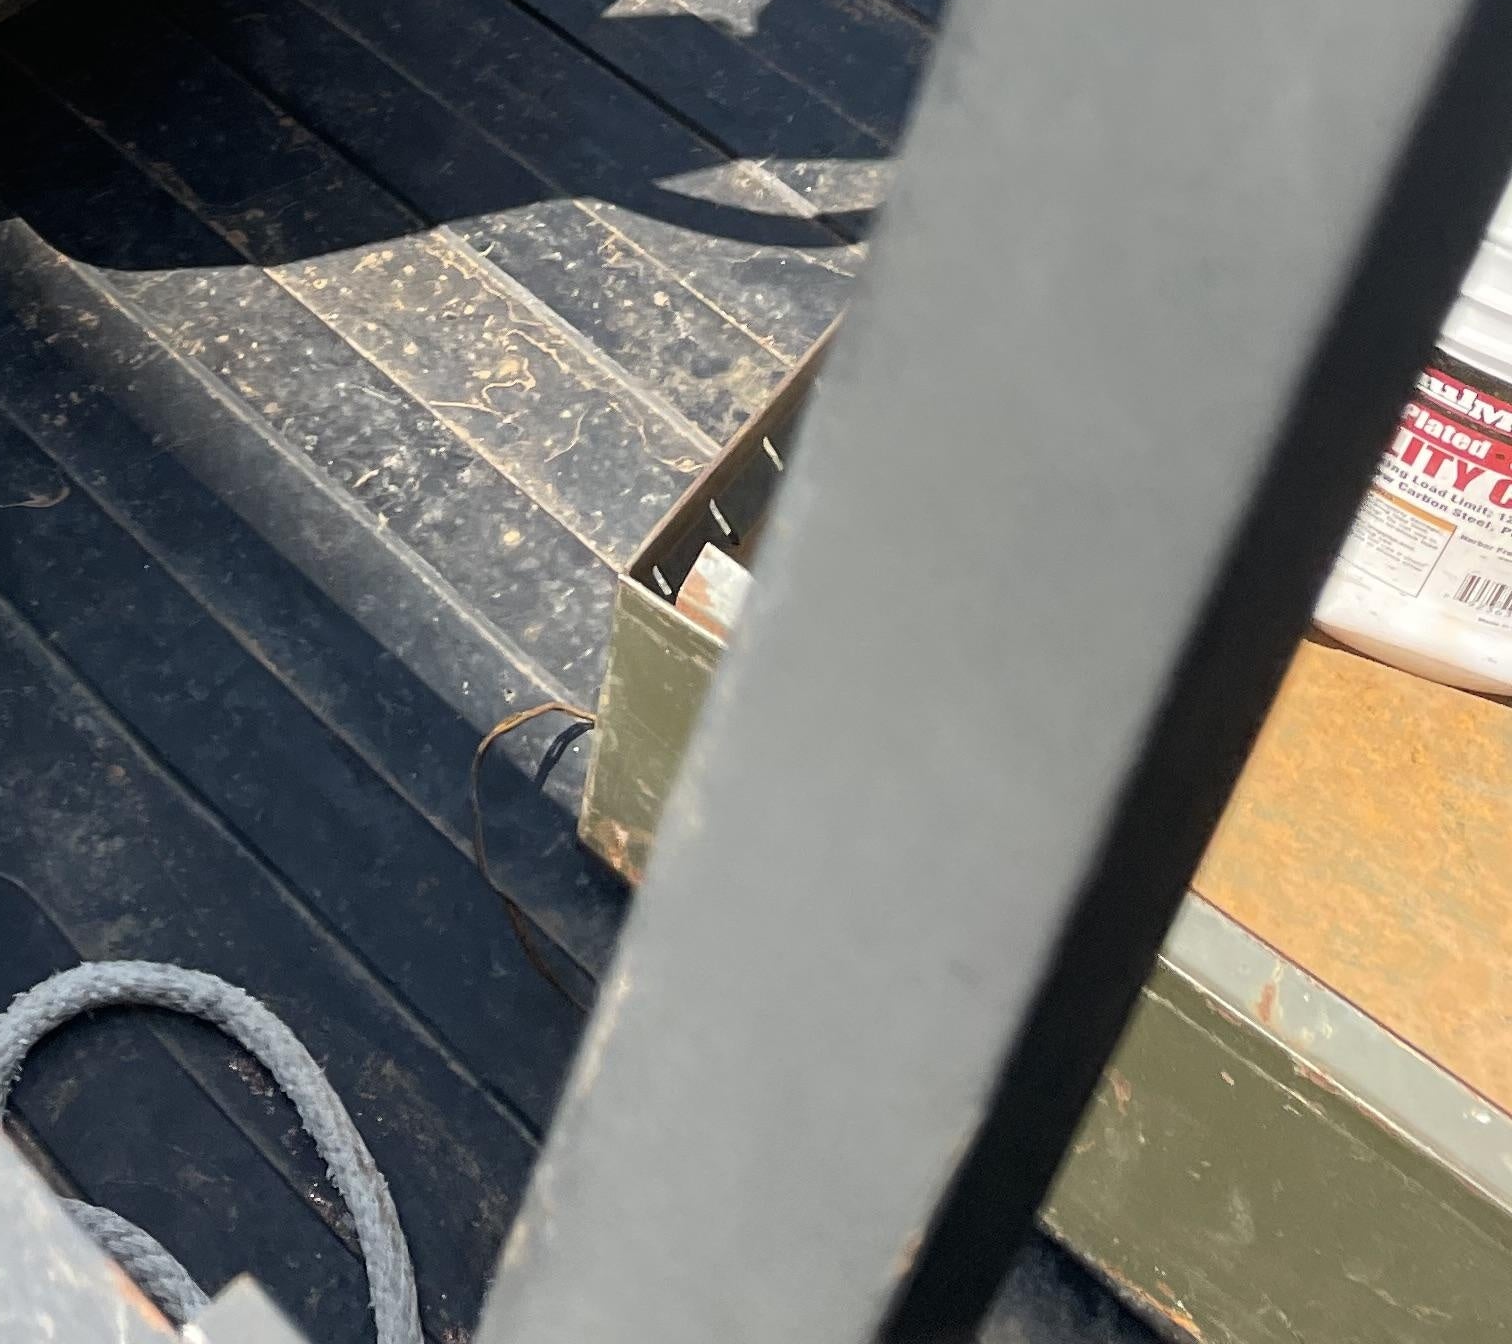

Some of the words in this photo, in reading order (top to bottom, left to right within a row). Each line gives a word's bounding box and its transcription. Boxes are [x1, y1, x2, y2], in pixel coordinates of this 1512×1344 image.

[1403, 403, 1492, 460] Plated
[1392, 436, 1486, 492] ITY
[1398, 481, 1448, 512] Carbon
[1412, 475, 1448, 498] Load
